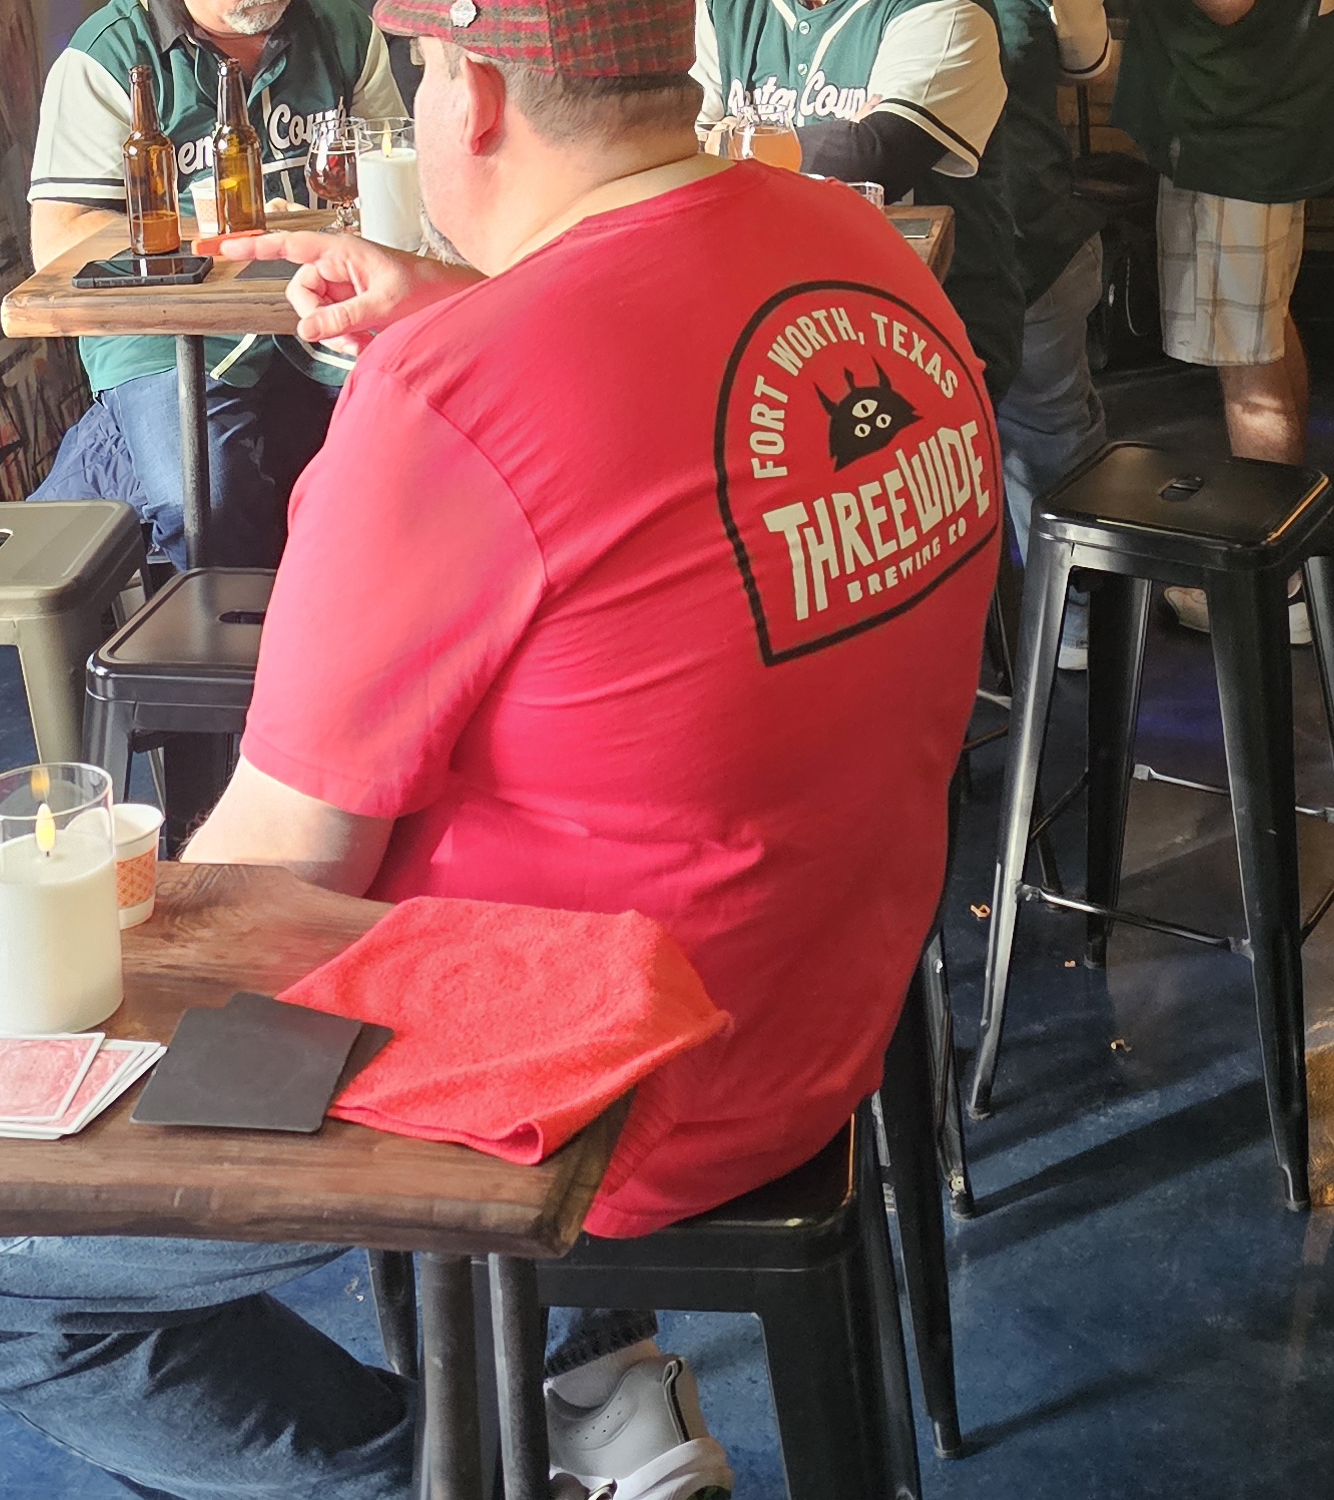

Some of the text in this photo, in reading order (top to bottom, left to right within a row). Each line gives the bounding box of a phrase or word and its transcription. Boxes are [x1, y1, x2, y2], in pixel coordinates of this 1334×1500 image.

[749, 306, 959, 480] FORT WORTH, TEXAS
[762, 420, 991, 622] THREEWIDE
[847, 517, 967, 603] BREWING CO
